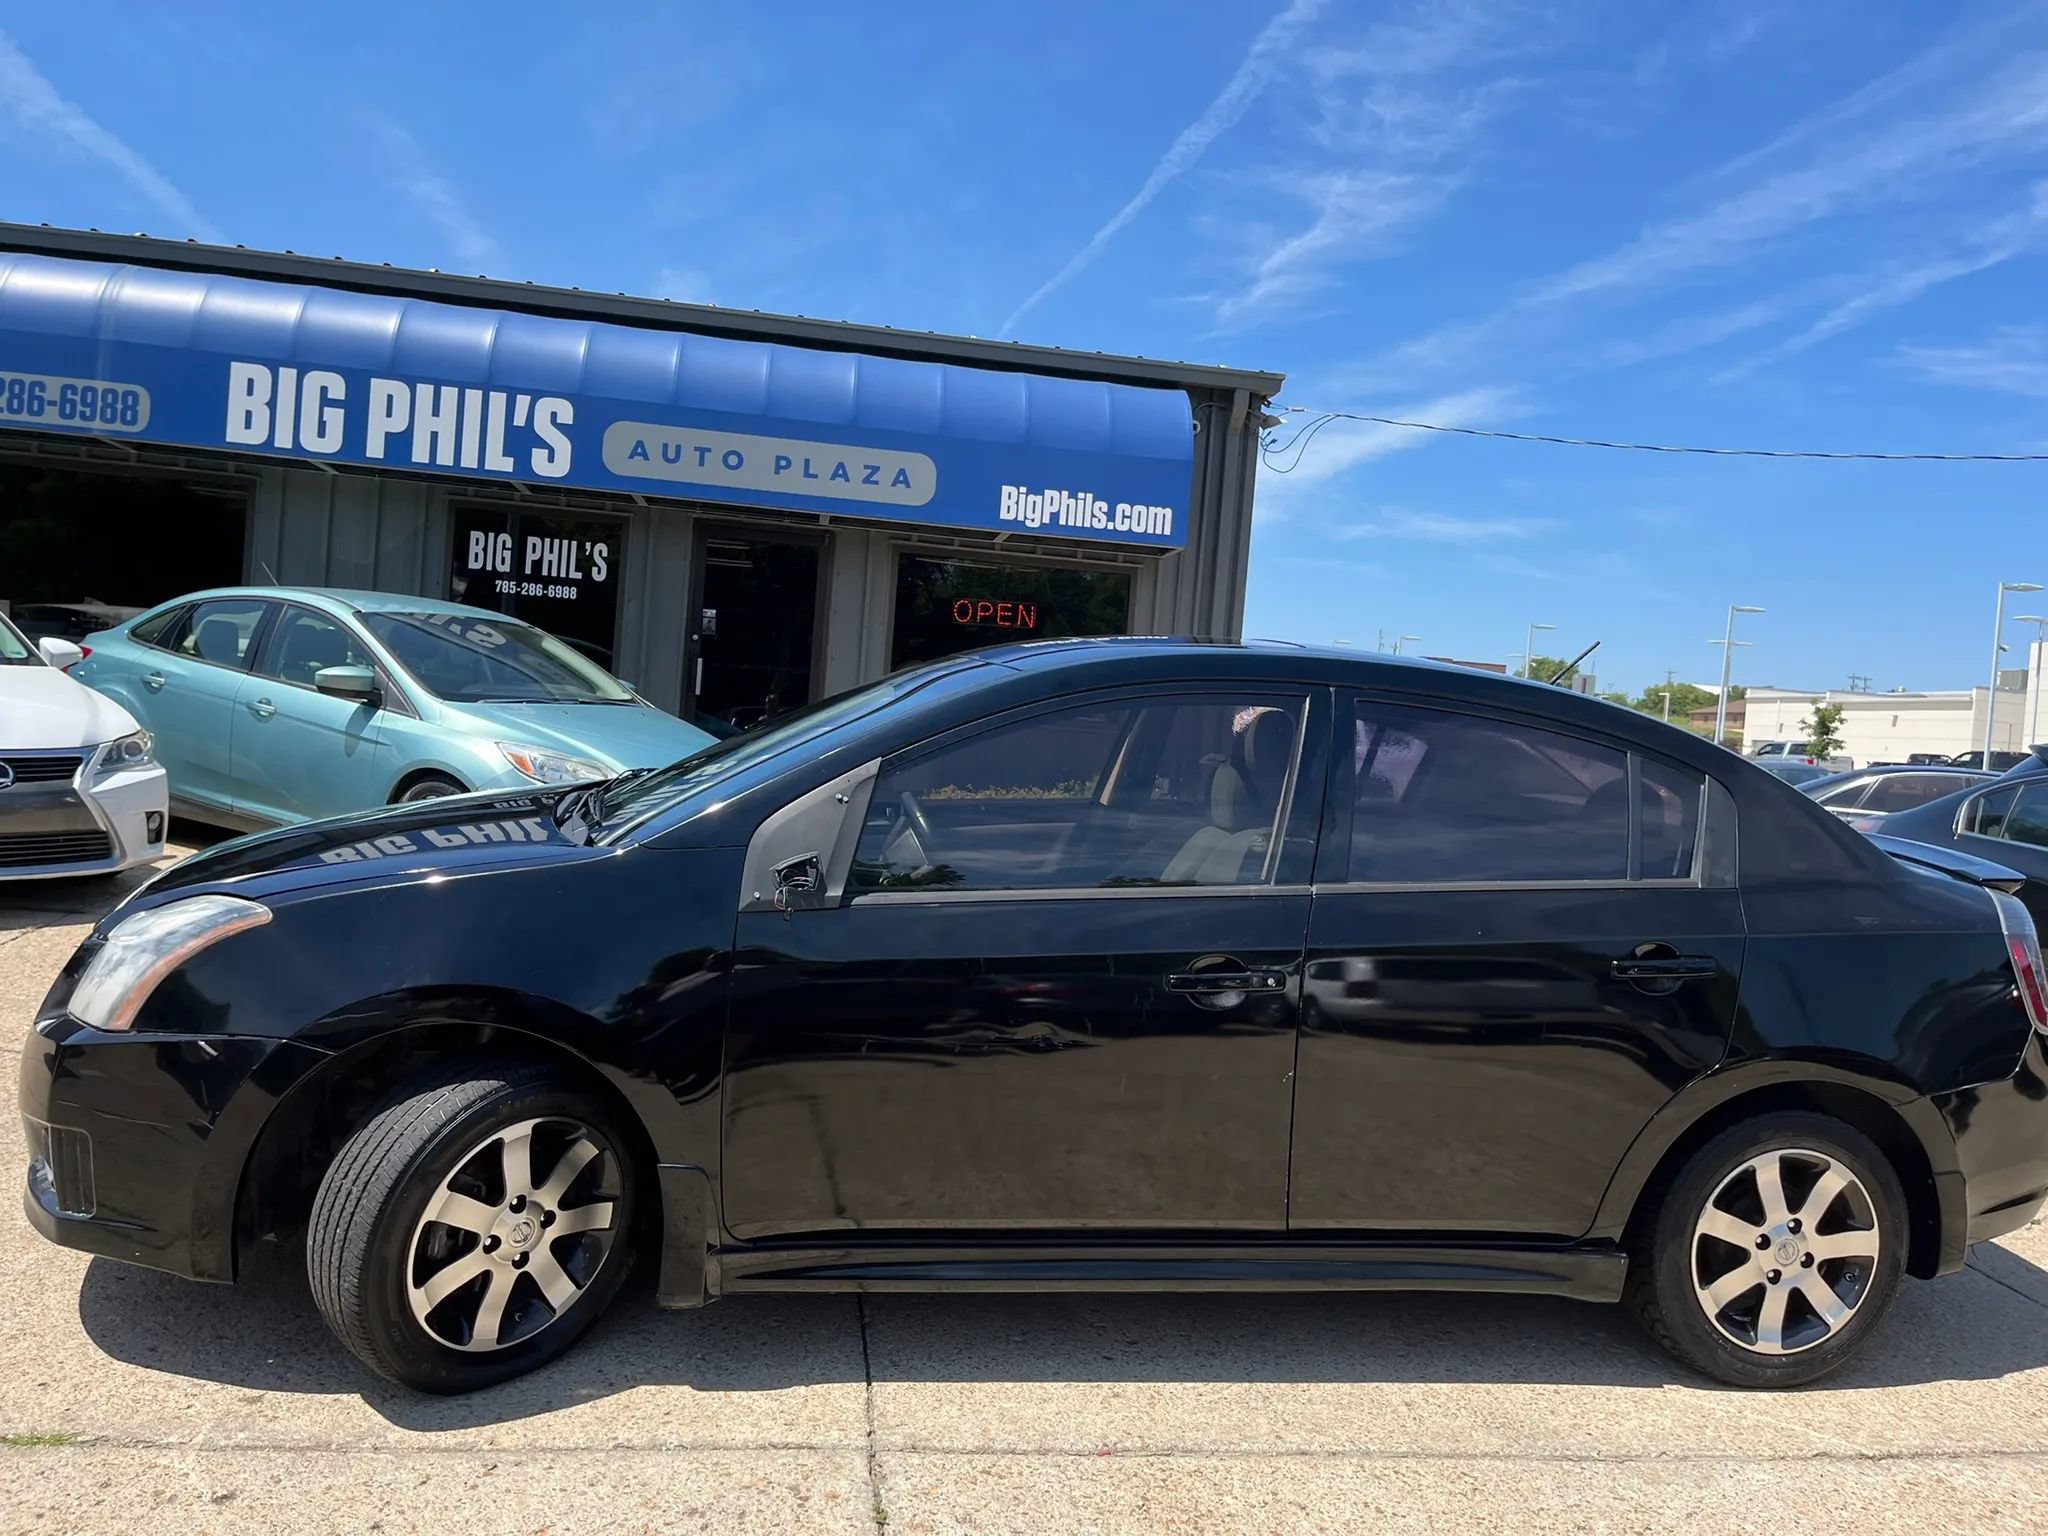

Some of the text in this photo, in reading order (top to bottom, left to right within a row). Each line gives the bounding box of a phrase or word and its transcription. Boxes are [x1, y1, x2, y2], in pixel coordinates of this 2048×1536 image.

[225, 361, 574, 478] BIG PHIL'S
[628, 439, 912, 489] AUTO PLAZA
[1000, 485, 1172, 536] BigPhils.com
[468, 530, 608, 582] BIG PHIL'S
[495, 579, 577, 600] 785-286-6988
[953, 599, 1036, 628] OPEN
